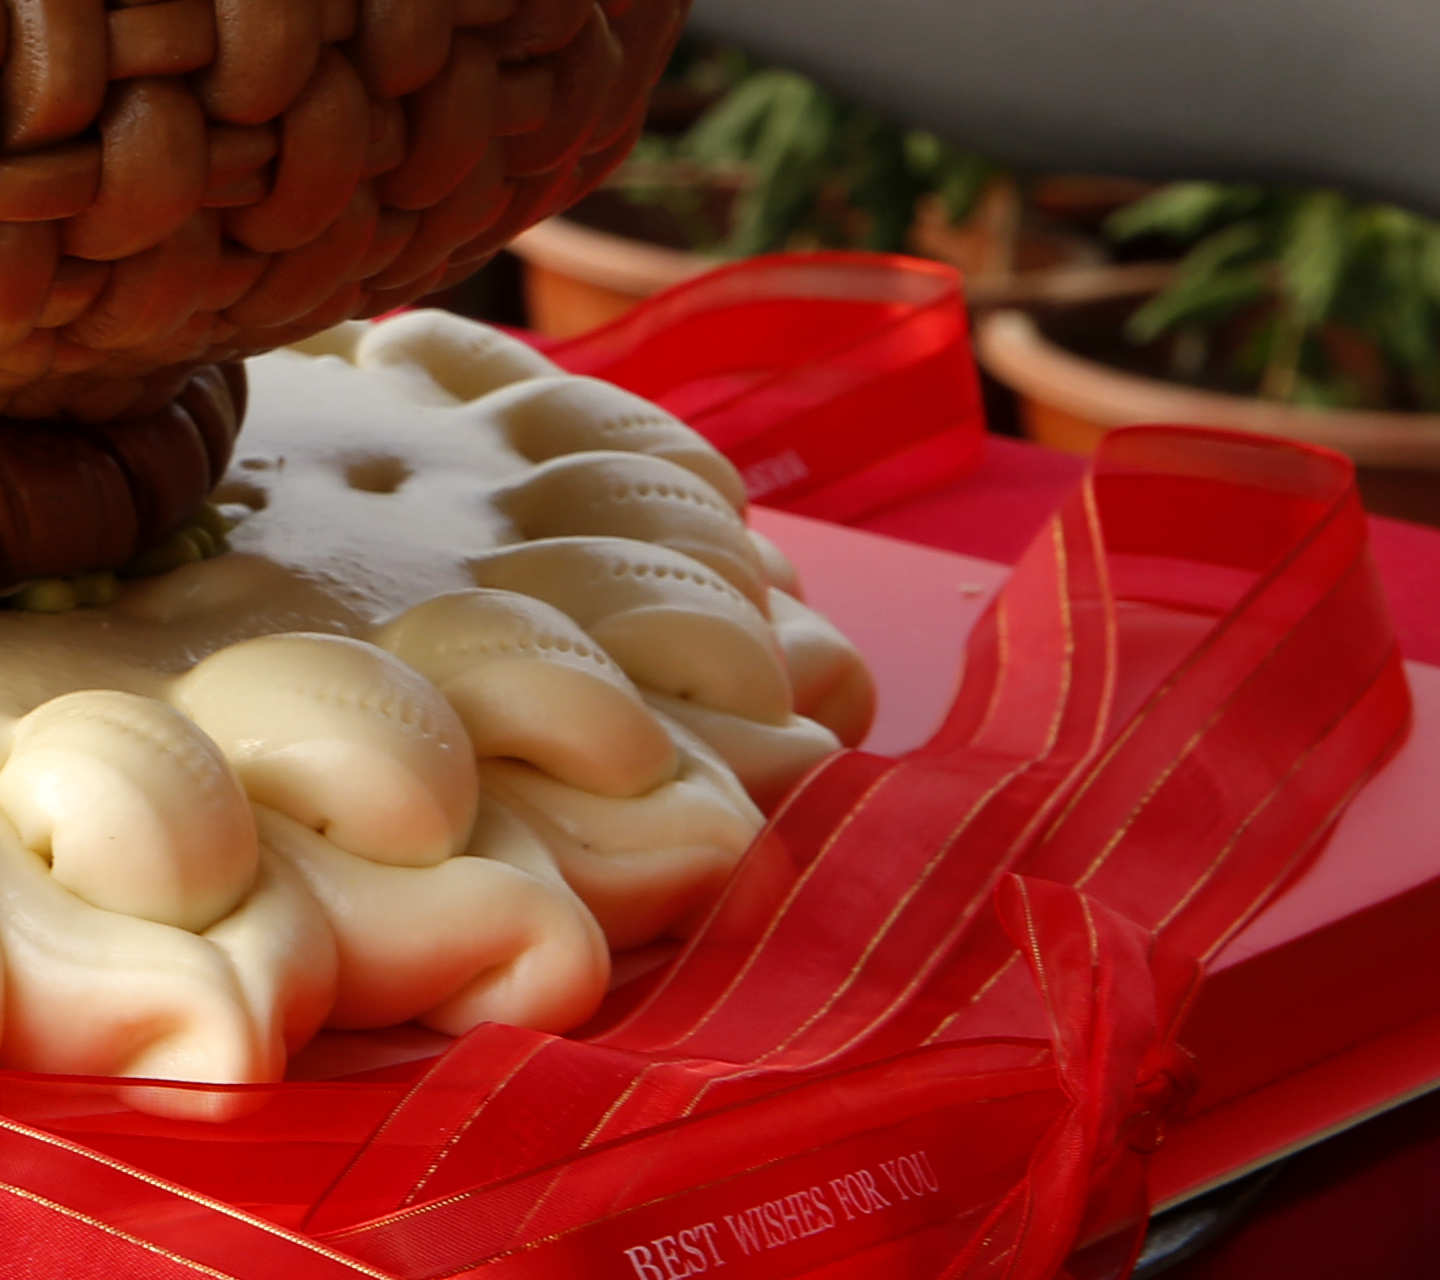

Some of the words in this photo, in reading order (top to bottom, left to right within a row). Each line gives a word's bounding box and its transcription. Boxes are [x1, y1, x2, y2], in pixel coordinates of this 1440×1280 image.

[624, 1222, 727, 1280] BEST
[723, 1186, 837, 1256] WISHES
[827, 1169, 893, 1221] FOR
[879, 1151, 940, 1201] YOU
